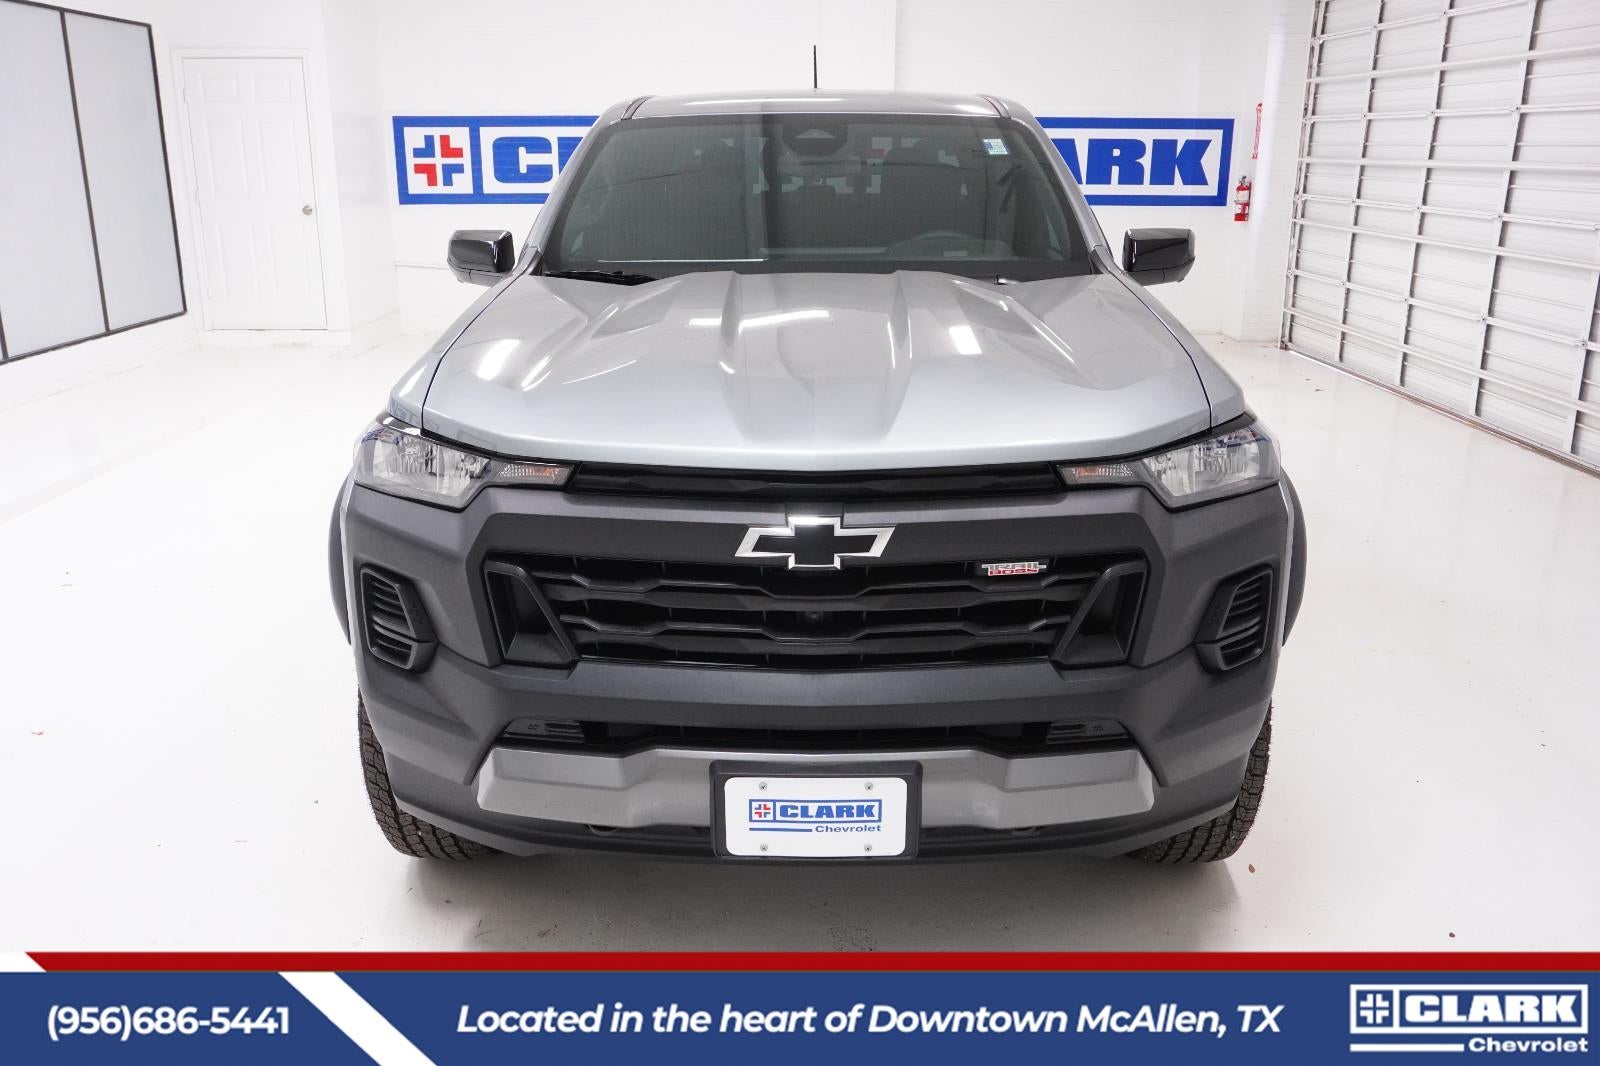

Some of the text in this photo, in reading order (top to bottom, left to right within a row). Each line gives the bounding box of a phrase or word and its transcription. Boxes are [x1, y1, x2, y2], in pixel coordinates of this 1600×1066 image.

[982, 562, 1047, 570] TRAIL
[779, 804, 876, 819] CLARK
[815, 824, 881, 833] Chevrolet
